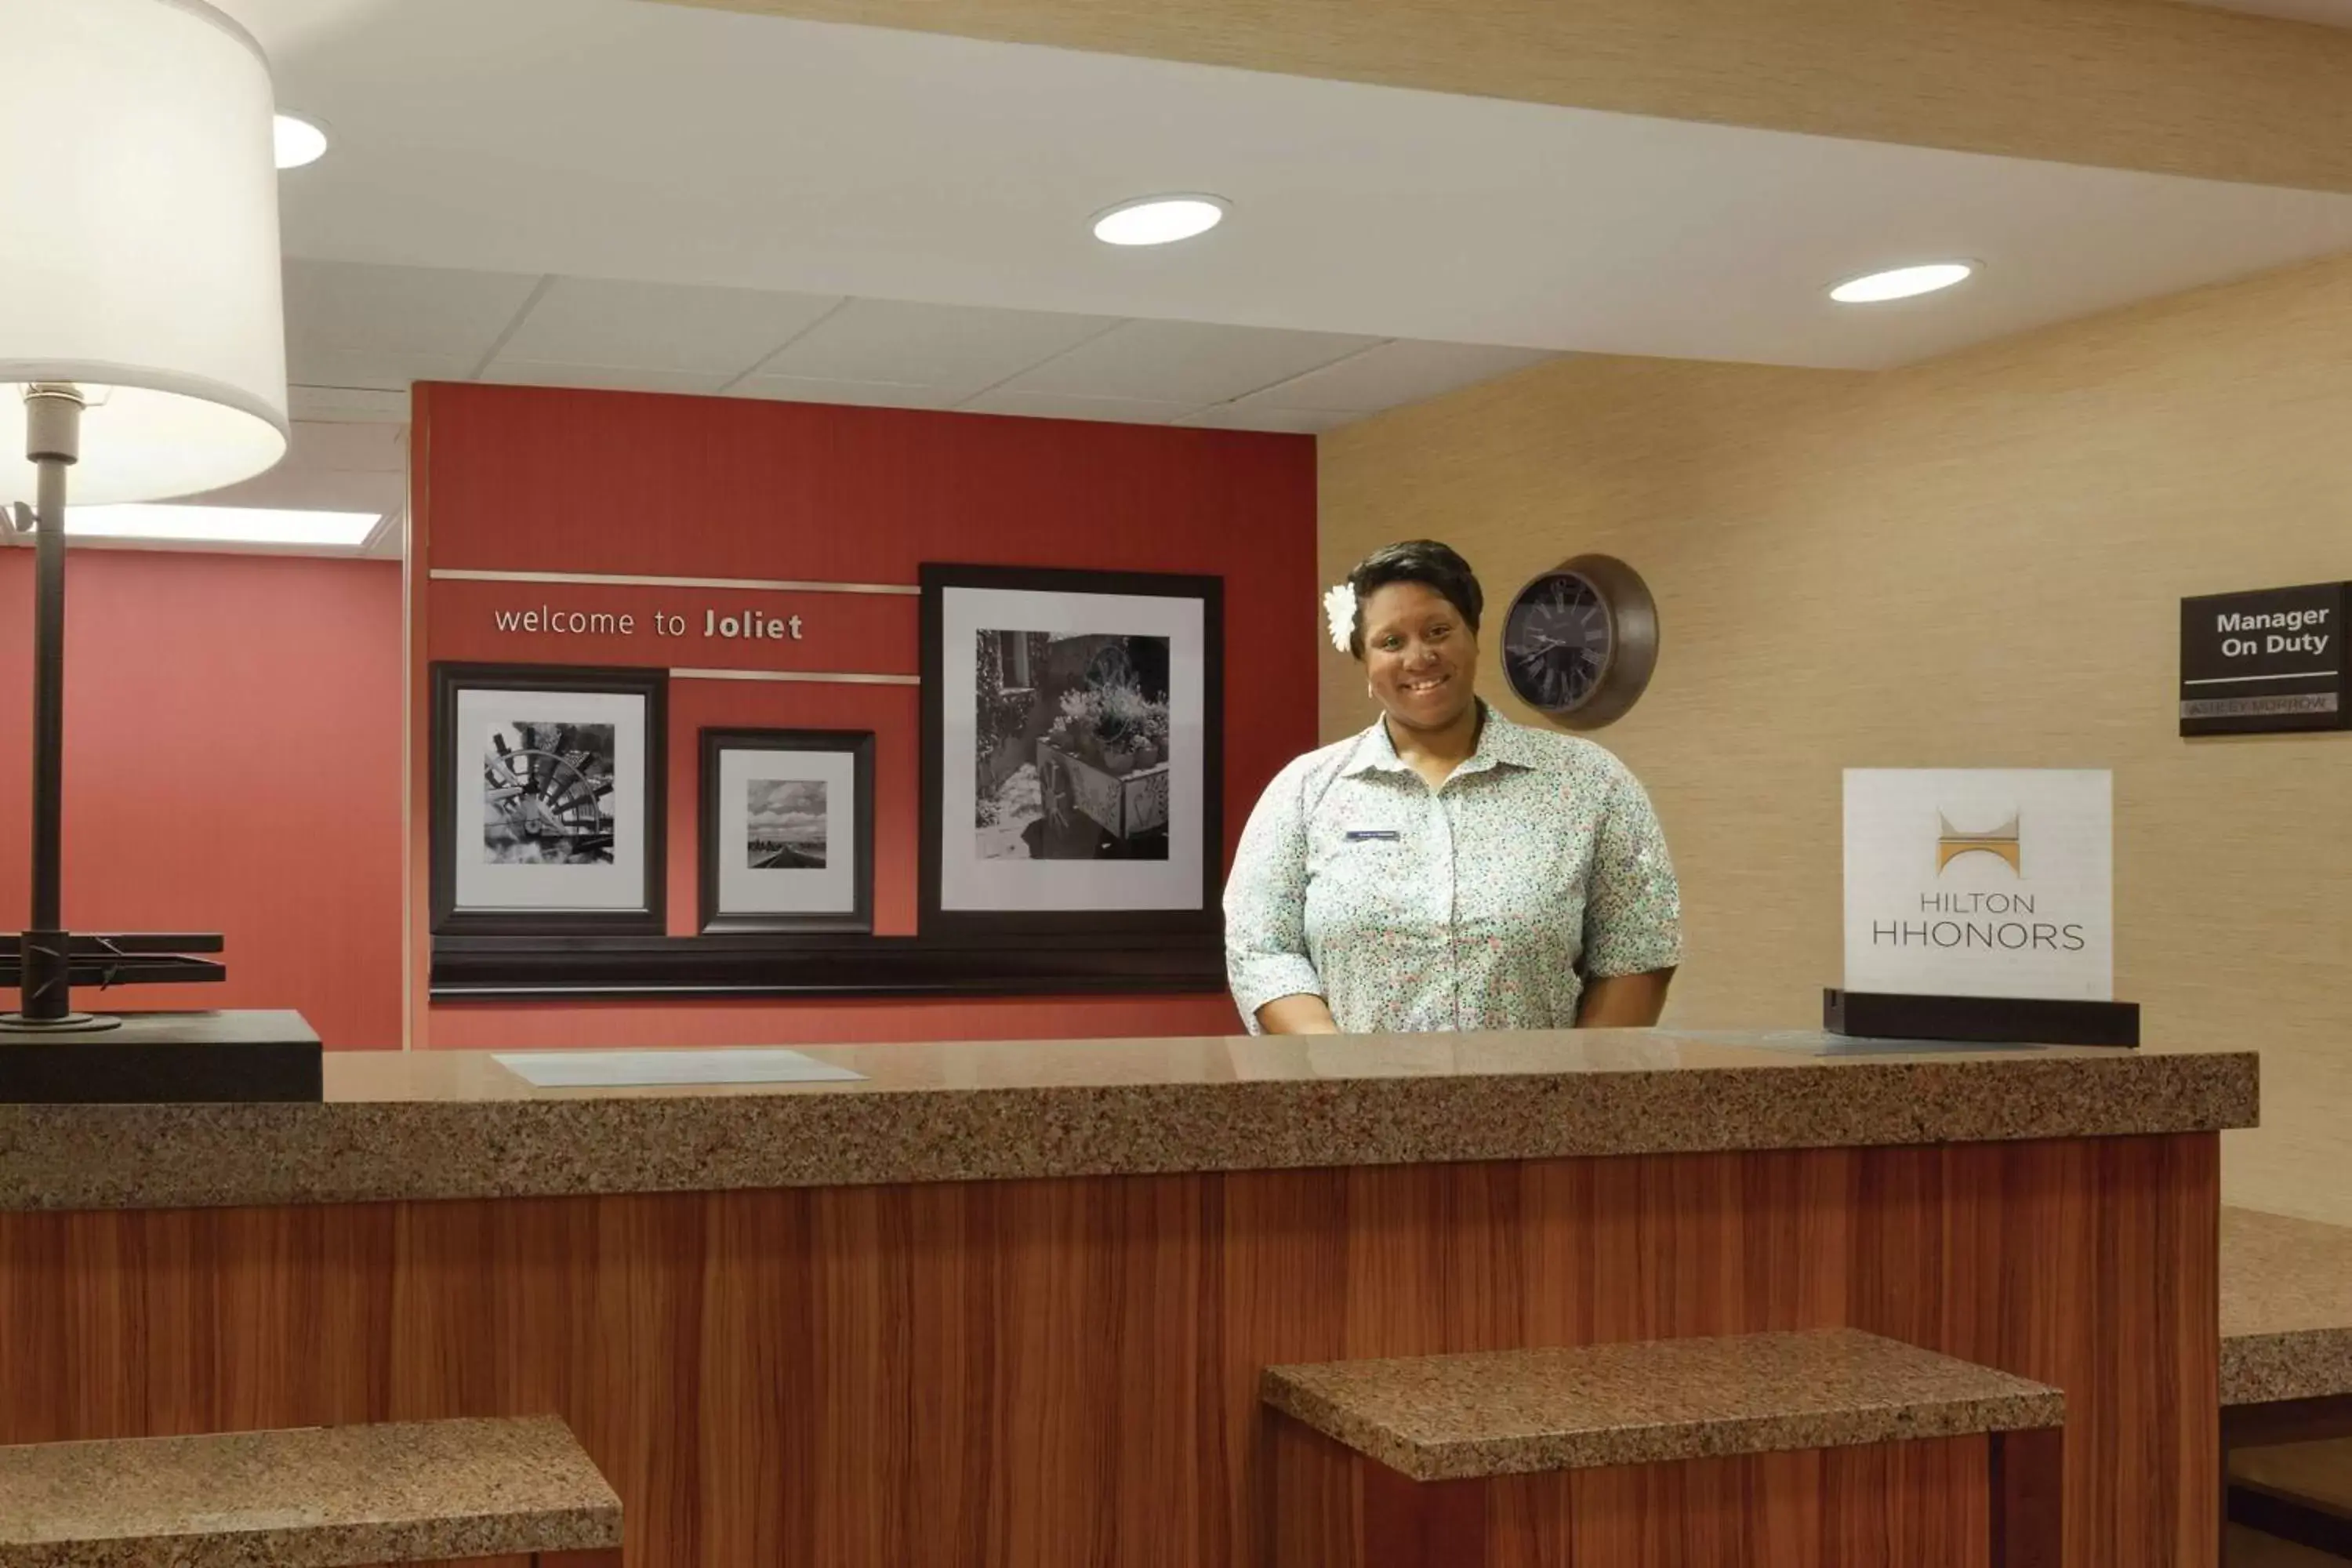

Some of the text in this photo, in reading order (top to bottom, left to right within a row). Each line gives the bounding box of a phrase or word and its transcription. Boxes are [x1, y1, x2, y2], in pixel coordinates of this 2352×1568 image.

[495, 604, 802, 640] welcome to Joliet
[2217, 608, 2329, 632] Manager
[2221, 633, 2328, 657] On Duty
[1921, 892, 2034, 913] HILTON
[1873, 920, 2085, 951] HHONORS
